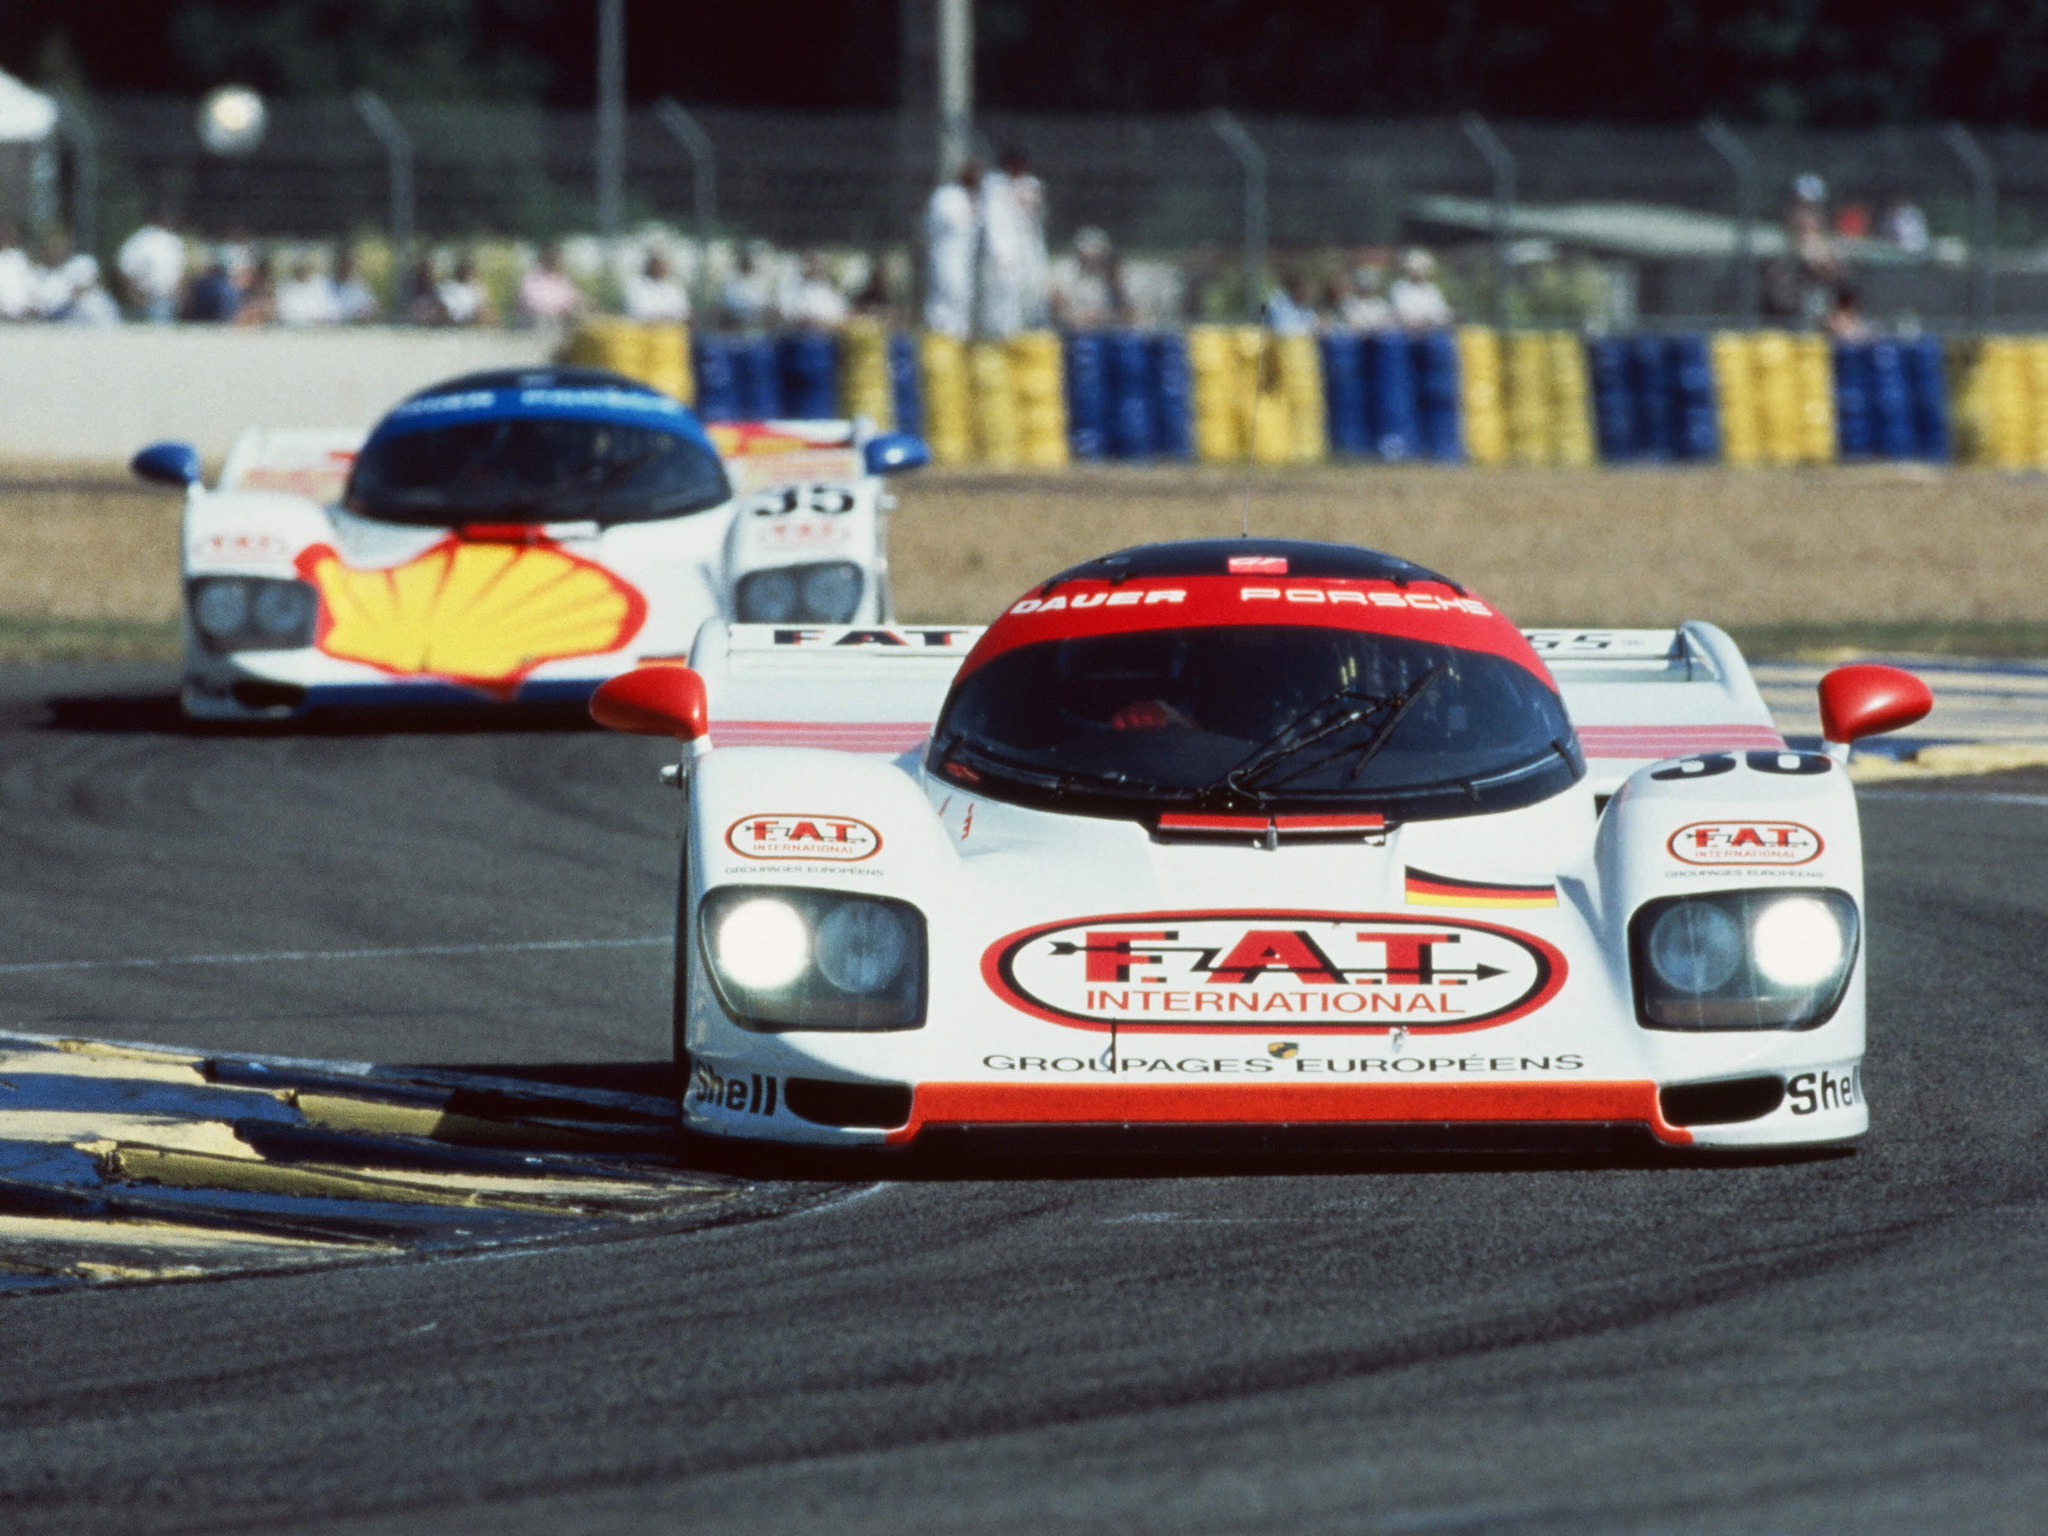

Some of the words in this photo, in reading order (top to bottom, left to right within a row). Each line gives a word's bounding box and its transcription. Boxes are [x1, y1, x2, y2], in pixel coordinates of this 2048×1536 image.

[1011, 589, 1187, 614] DAUER
[1240, 588, 1493, 616] PORSCHE
[774, 629, 967, 646] FAT
[753, 843, 853, 855] INTERNATIONAL
[1695, 849, 1796, 859] INTERNATIONAL
[1086, 990, 1465, 1014] INTERNATIONAL
[983, 1054, 1273, 1074] GROUPAGES
[1296, 1053, 1585, 1074] EUROPÉENS
